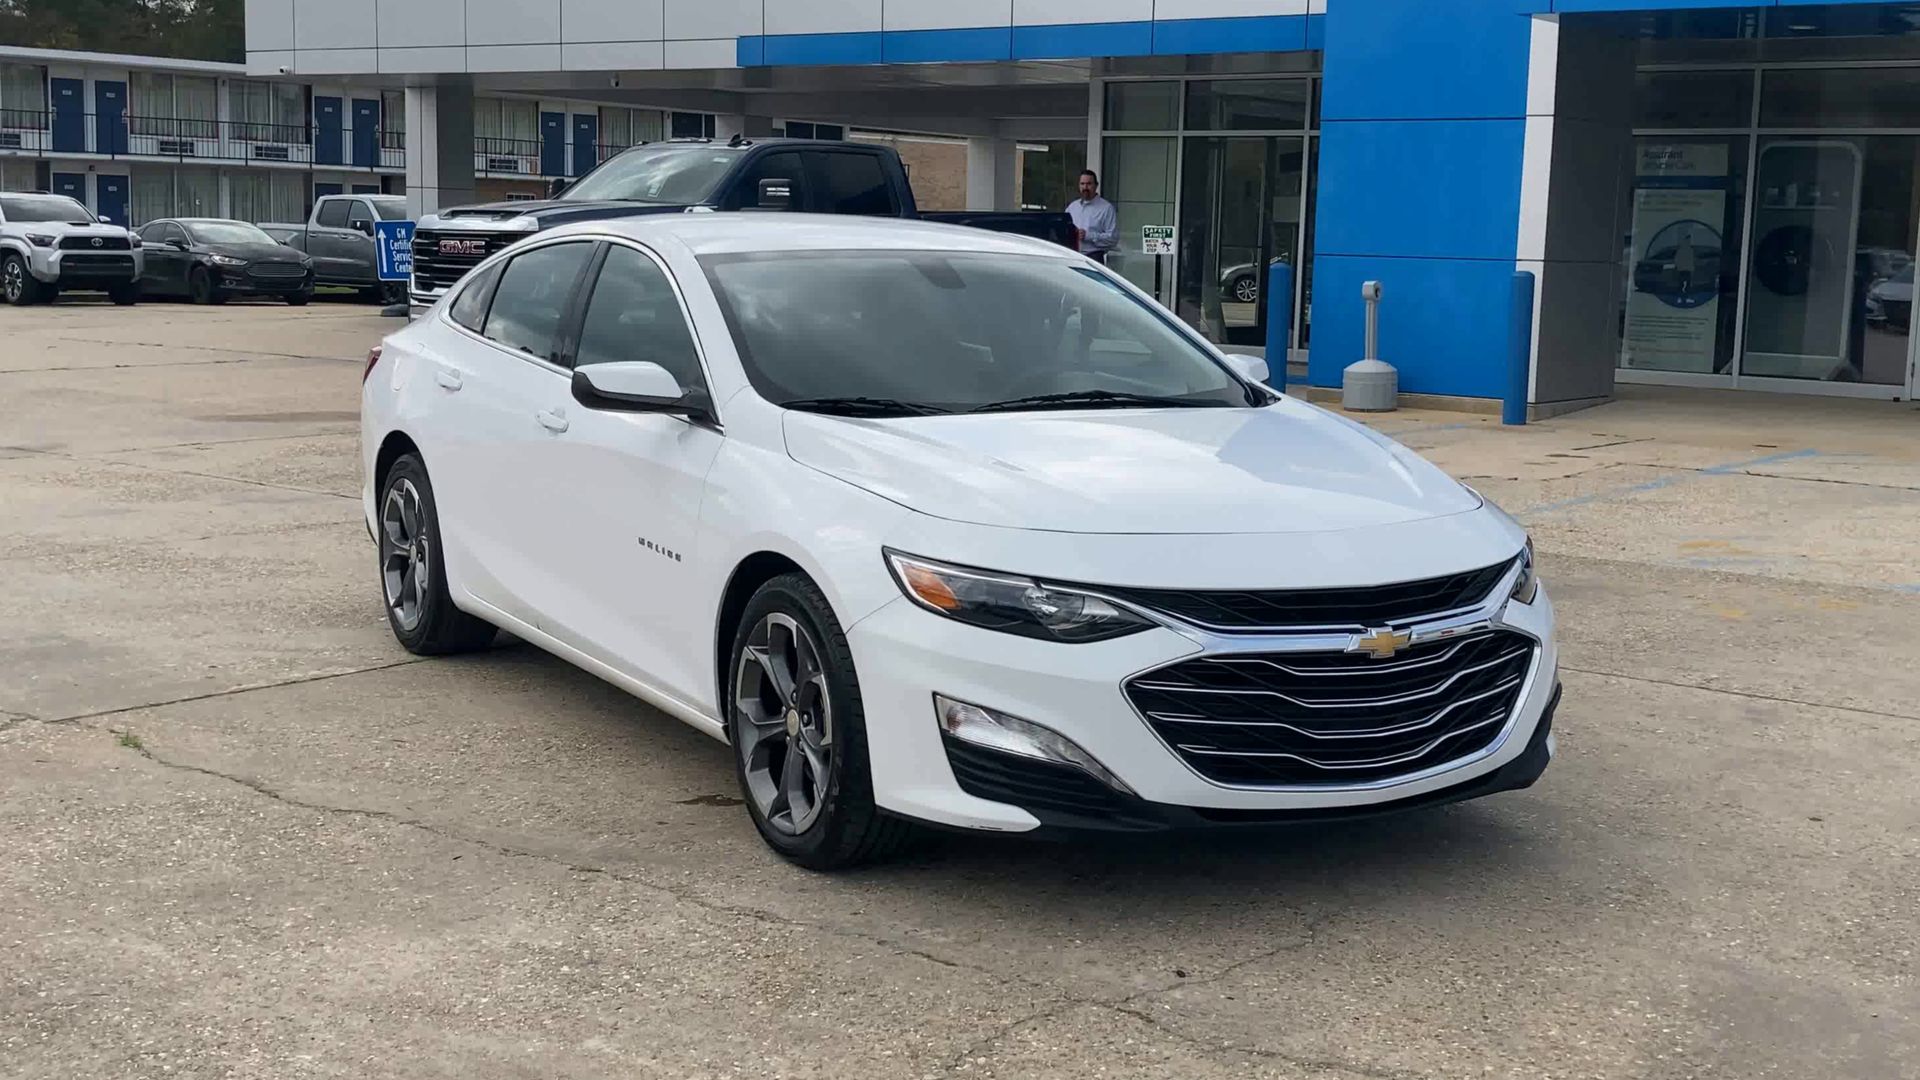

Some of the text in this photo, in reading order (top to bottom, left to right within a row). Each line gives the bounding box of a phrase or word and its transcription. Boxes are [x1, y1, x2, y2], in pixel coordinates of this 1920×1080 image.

[396, 228, 407, 239] GM
[389, 239, 412, 250] Certifie
[440, 240, 486, 254] GMC
[392, 251, 412, 262] Servic
[394, 262, 412, 273] Cente
